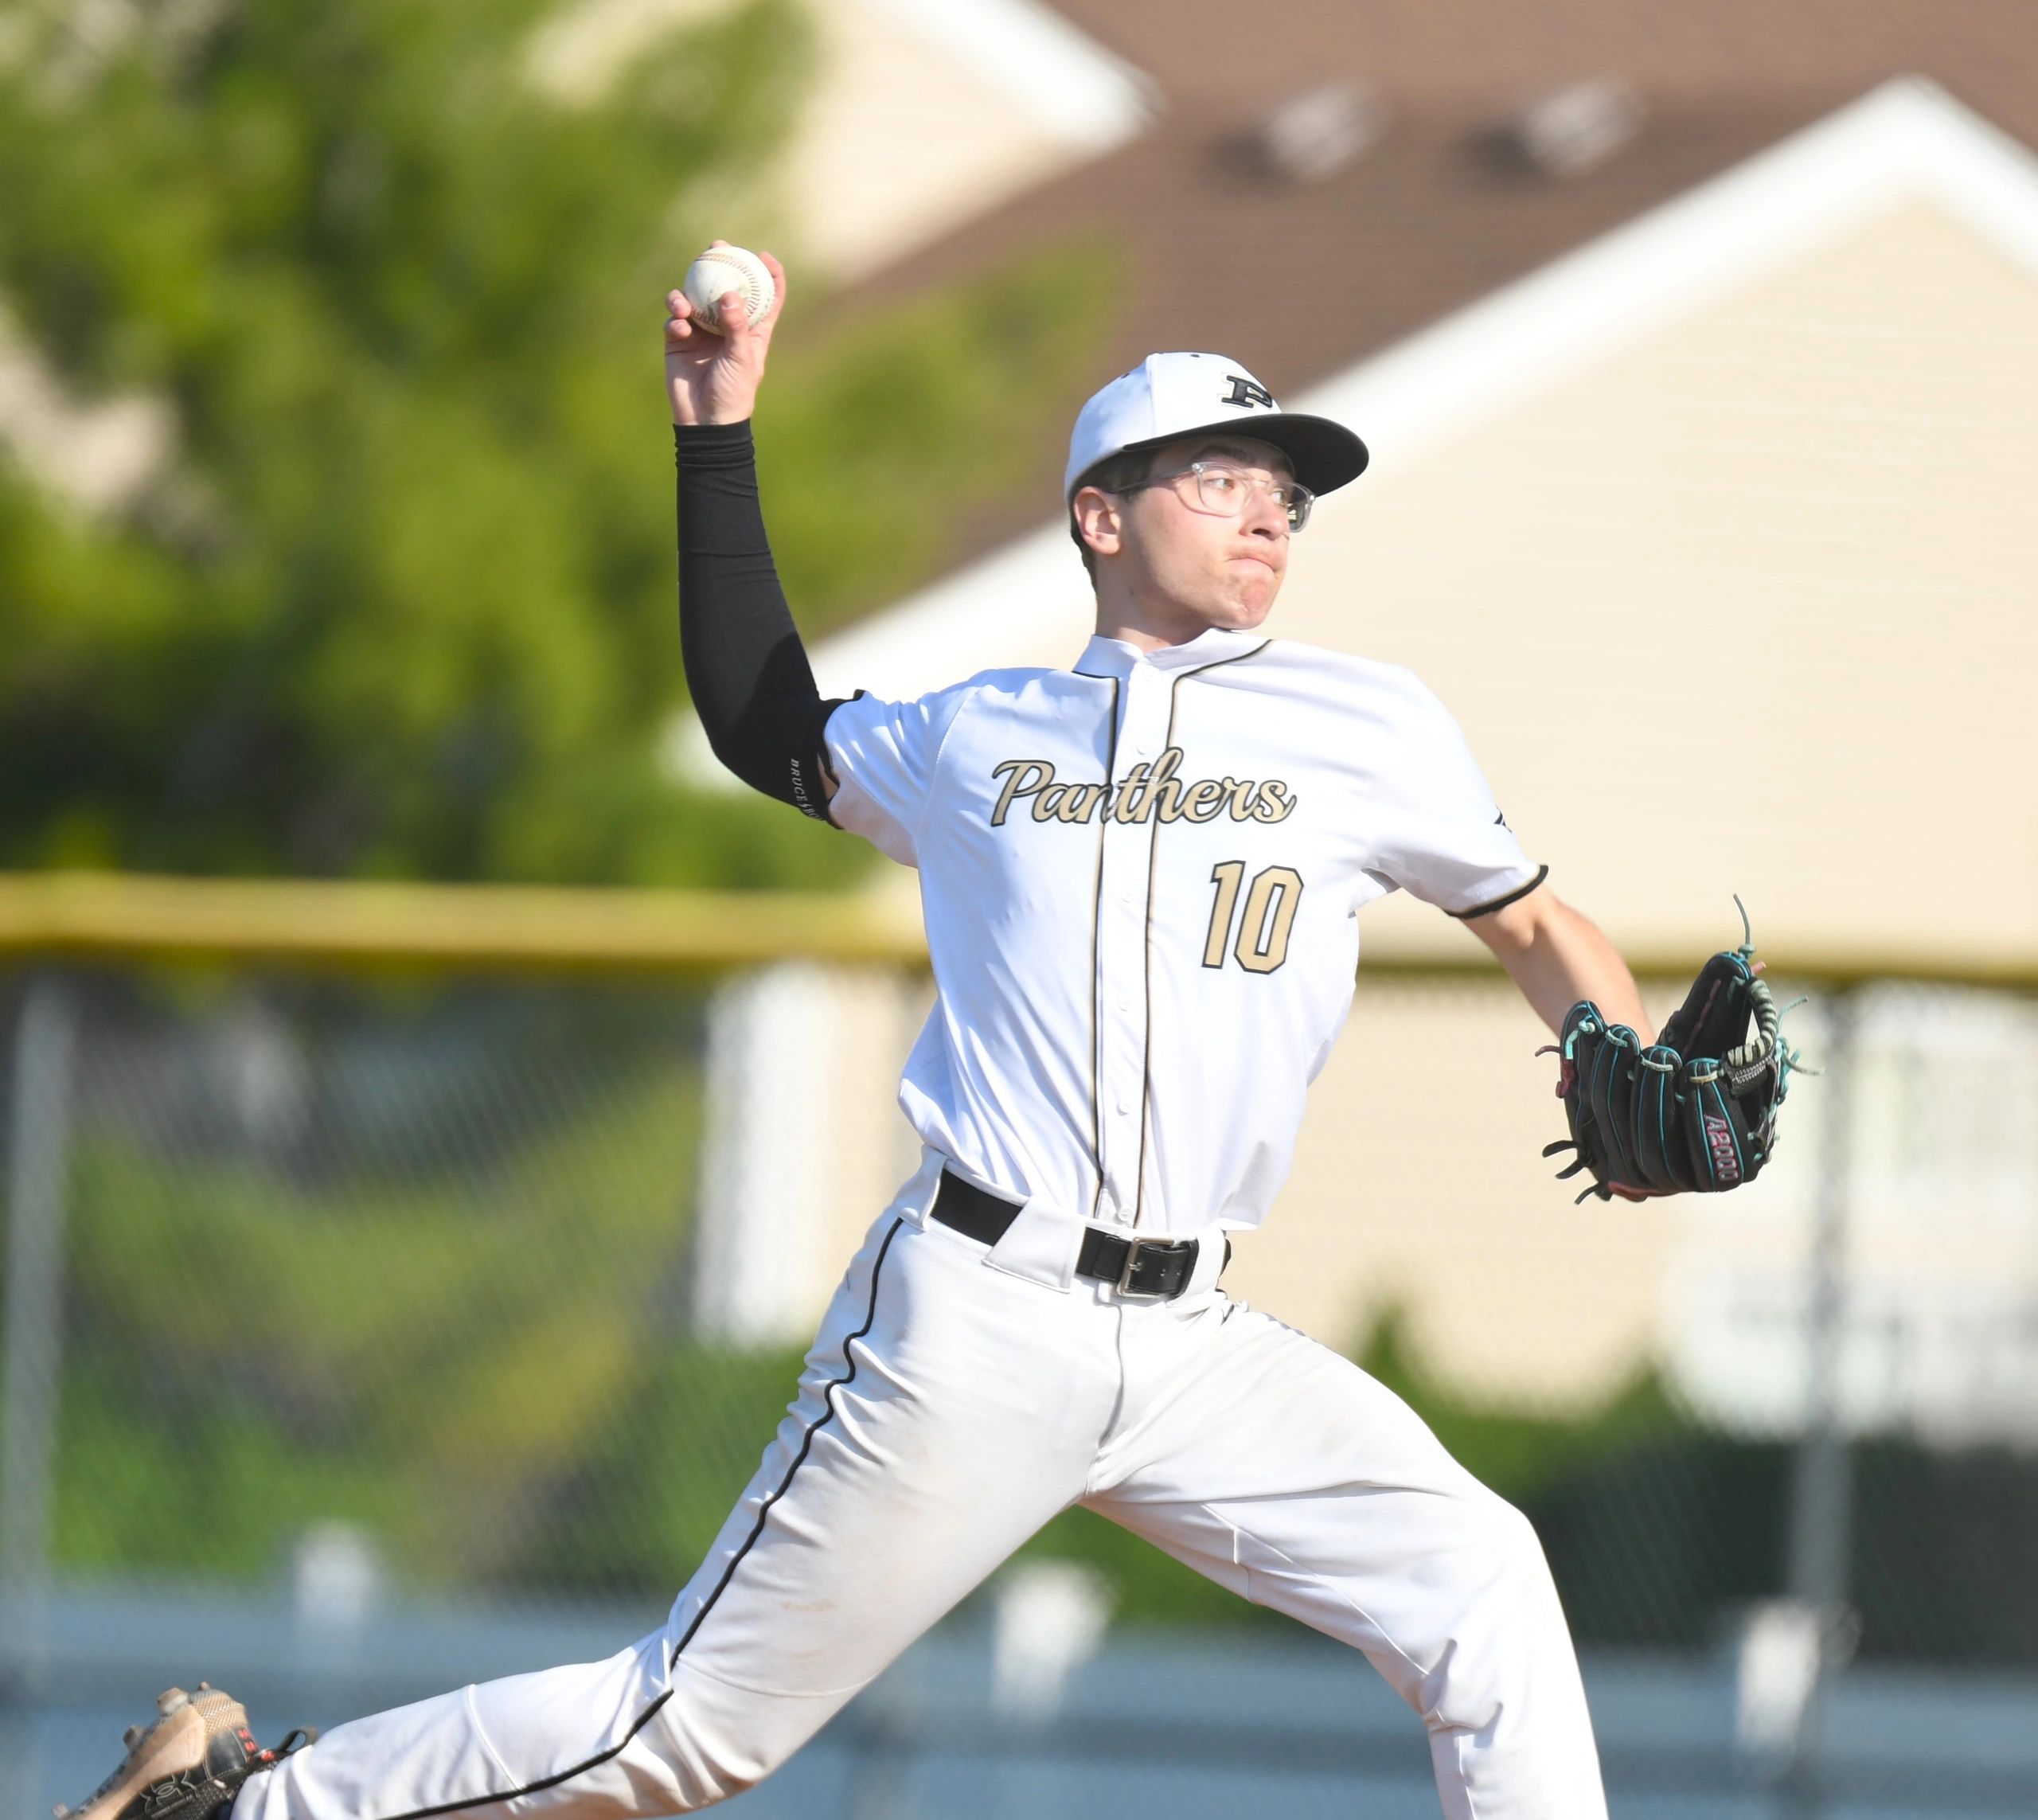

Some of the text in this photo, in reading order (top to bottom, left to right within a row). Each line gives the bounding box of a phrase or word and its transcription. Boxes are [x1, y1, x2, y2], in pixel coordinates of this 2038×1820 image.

[1221, 375, 1273, 408] P
[791, 758, 808, 802] BRUCE
[990, 746, 1298, 827] Panthers
[1201, 859, 1305, 975] 10
[1704, 1114, 1739, 1181] A2000
